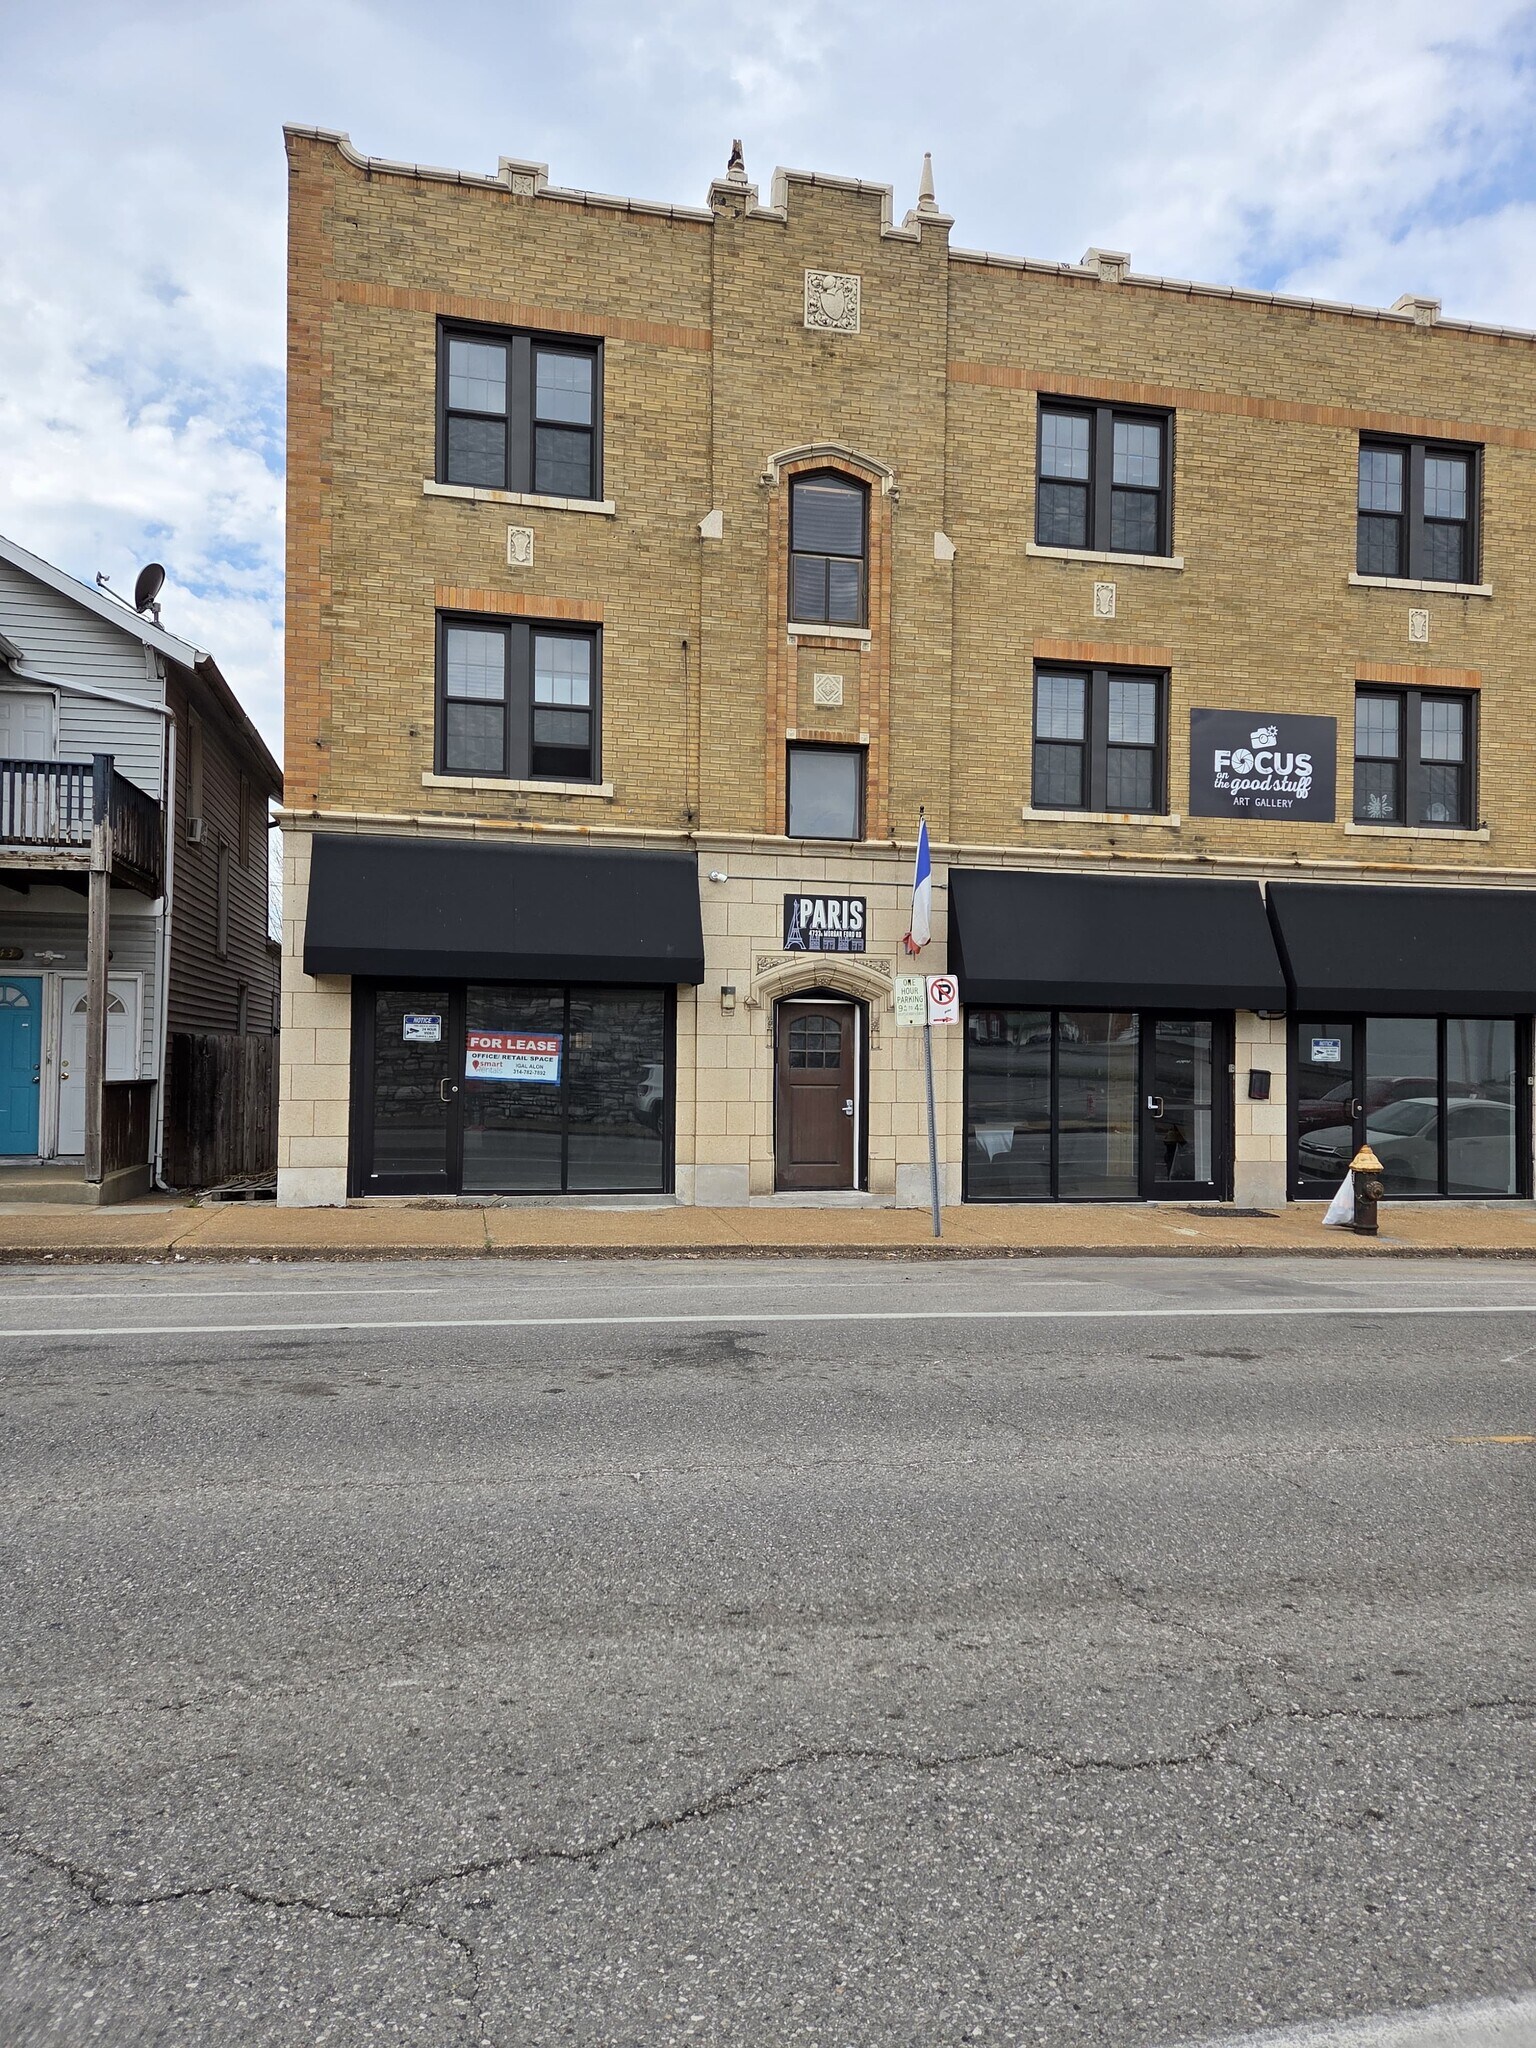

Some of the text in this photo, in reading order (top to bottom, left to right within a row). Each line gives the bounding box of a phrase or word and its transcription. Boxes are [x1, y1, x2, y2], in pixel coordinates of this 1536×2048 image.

[1214, 748, 1313, 776] FOCUS
[1214, 778, 1230, 789] the
[1233, 797, 1293, 808] ART GALLERY
[800, 899, 863, 930] PARIS
[901, 987, 919, 995] HOUR
[897, 995, 923, 1003] PARKING
[470, 1037, 556, 1051] FOR LEASE
